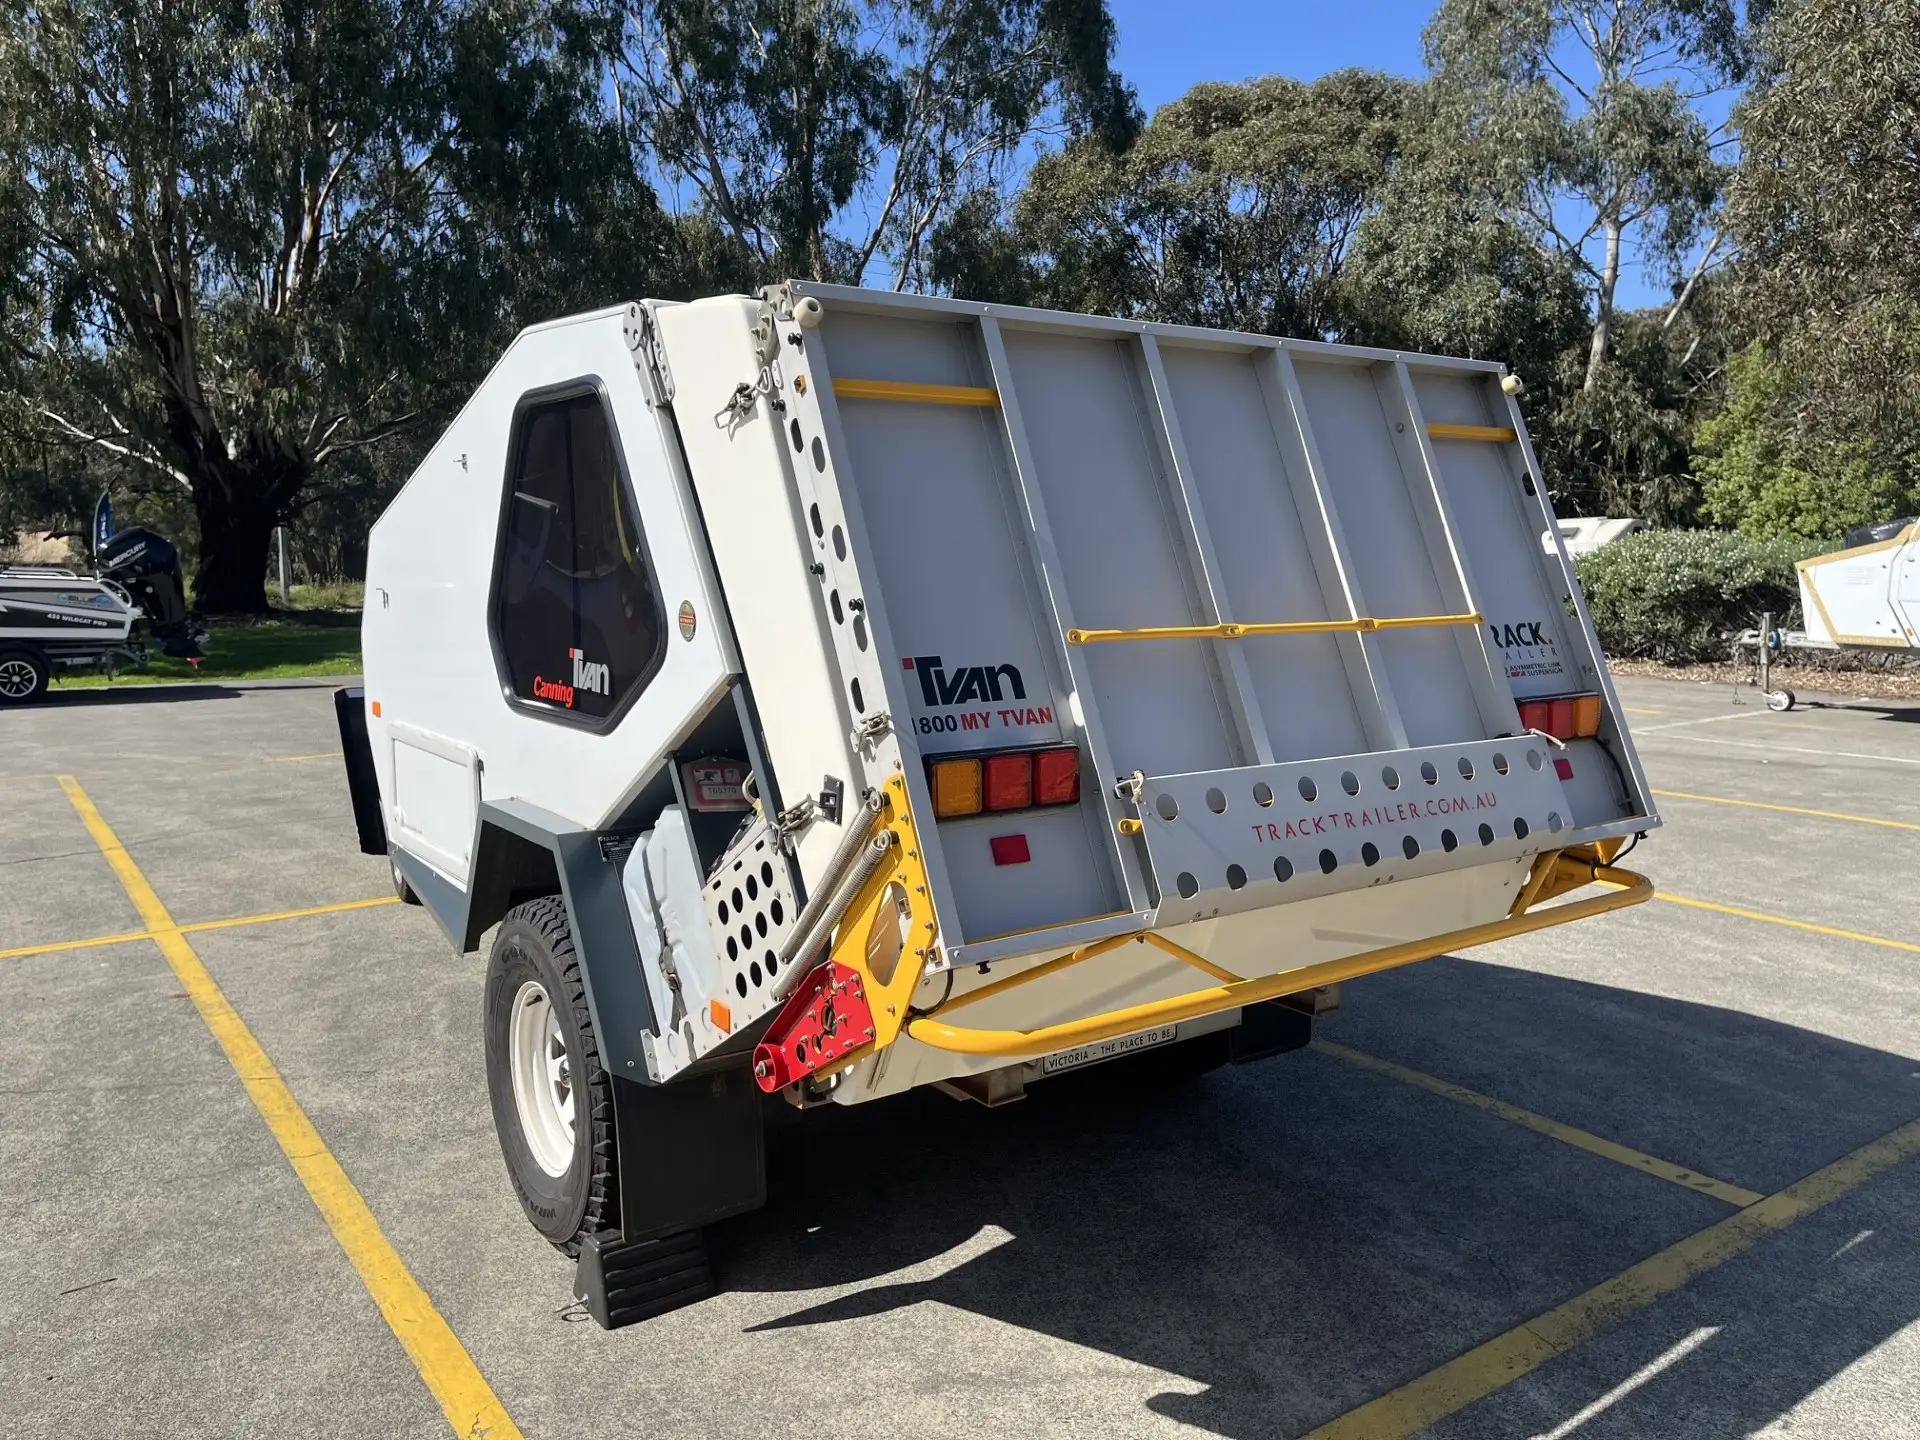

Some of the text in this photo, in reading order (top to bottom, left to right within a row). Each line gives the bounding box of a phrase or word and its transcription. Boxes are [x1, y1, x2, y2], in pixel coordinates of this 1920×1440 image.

[109, 541, 146, 567] MERCURY
[62, 615, 91, 624] WILDCAT
[1490, 622, 1553, 648] RACK.
[1505, 647, 1557, 660] AILER
[1510, 663, 1546, 671] ASYMMETRIC
[1527, 668, 1563, 677] SUSPENSION
[534, 676, 573, 708] Canning
[960, 712, 990, 730] MY
[998, 707, 1053, 727] TVAN
[1252, 792, 1497, 843] TRACKTRAILER.COM.AU
[1049, 1051, 1088, 1068] VICTORIA
[1101, 1043, 1115, 1055] THE
[1120, 1036, 1143, 1050] PLACE
[1147, 1032, 1157, 1042] TO
[1161, 1028, 1170, 1039] BE
